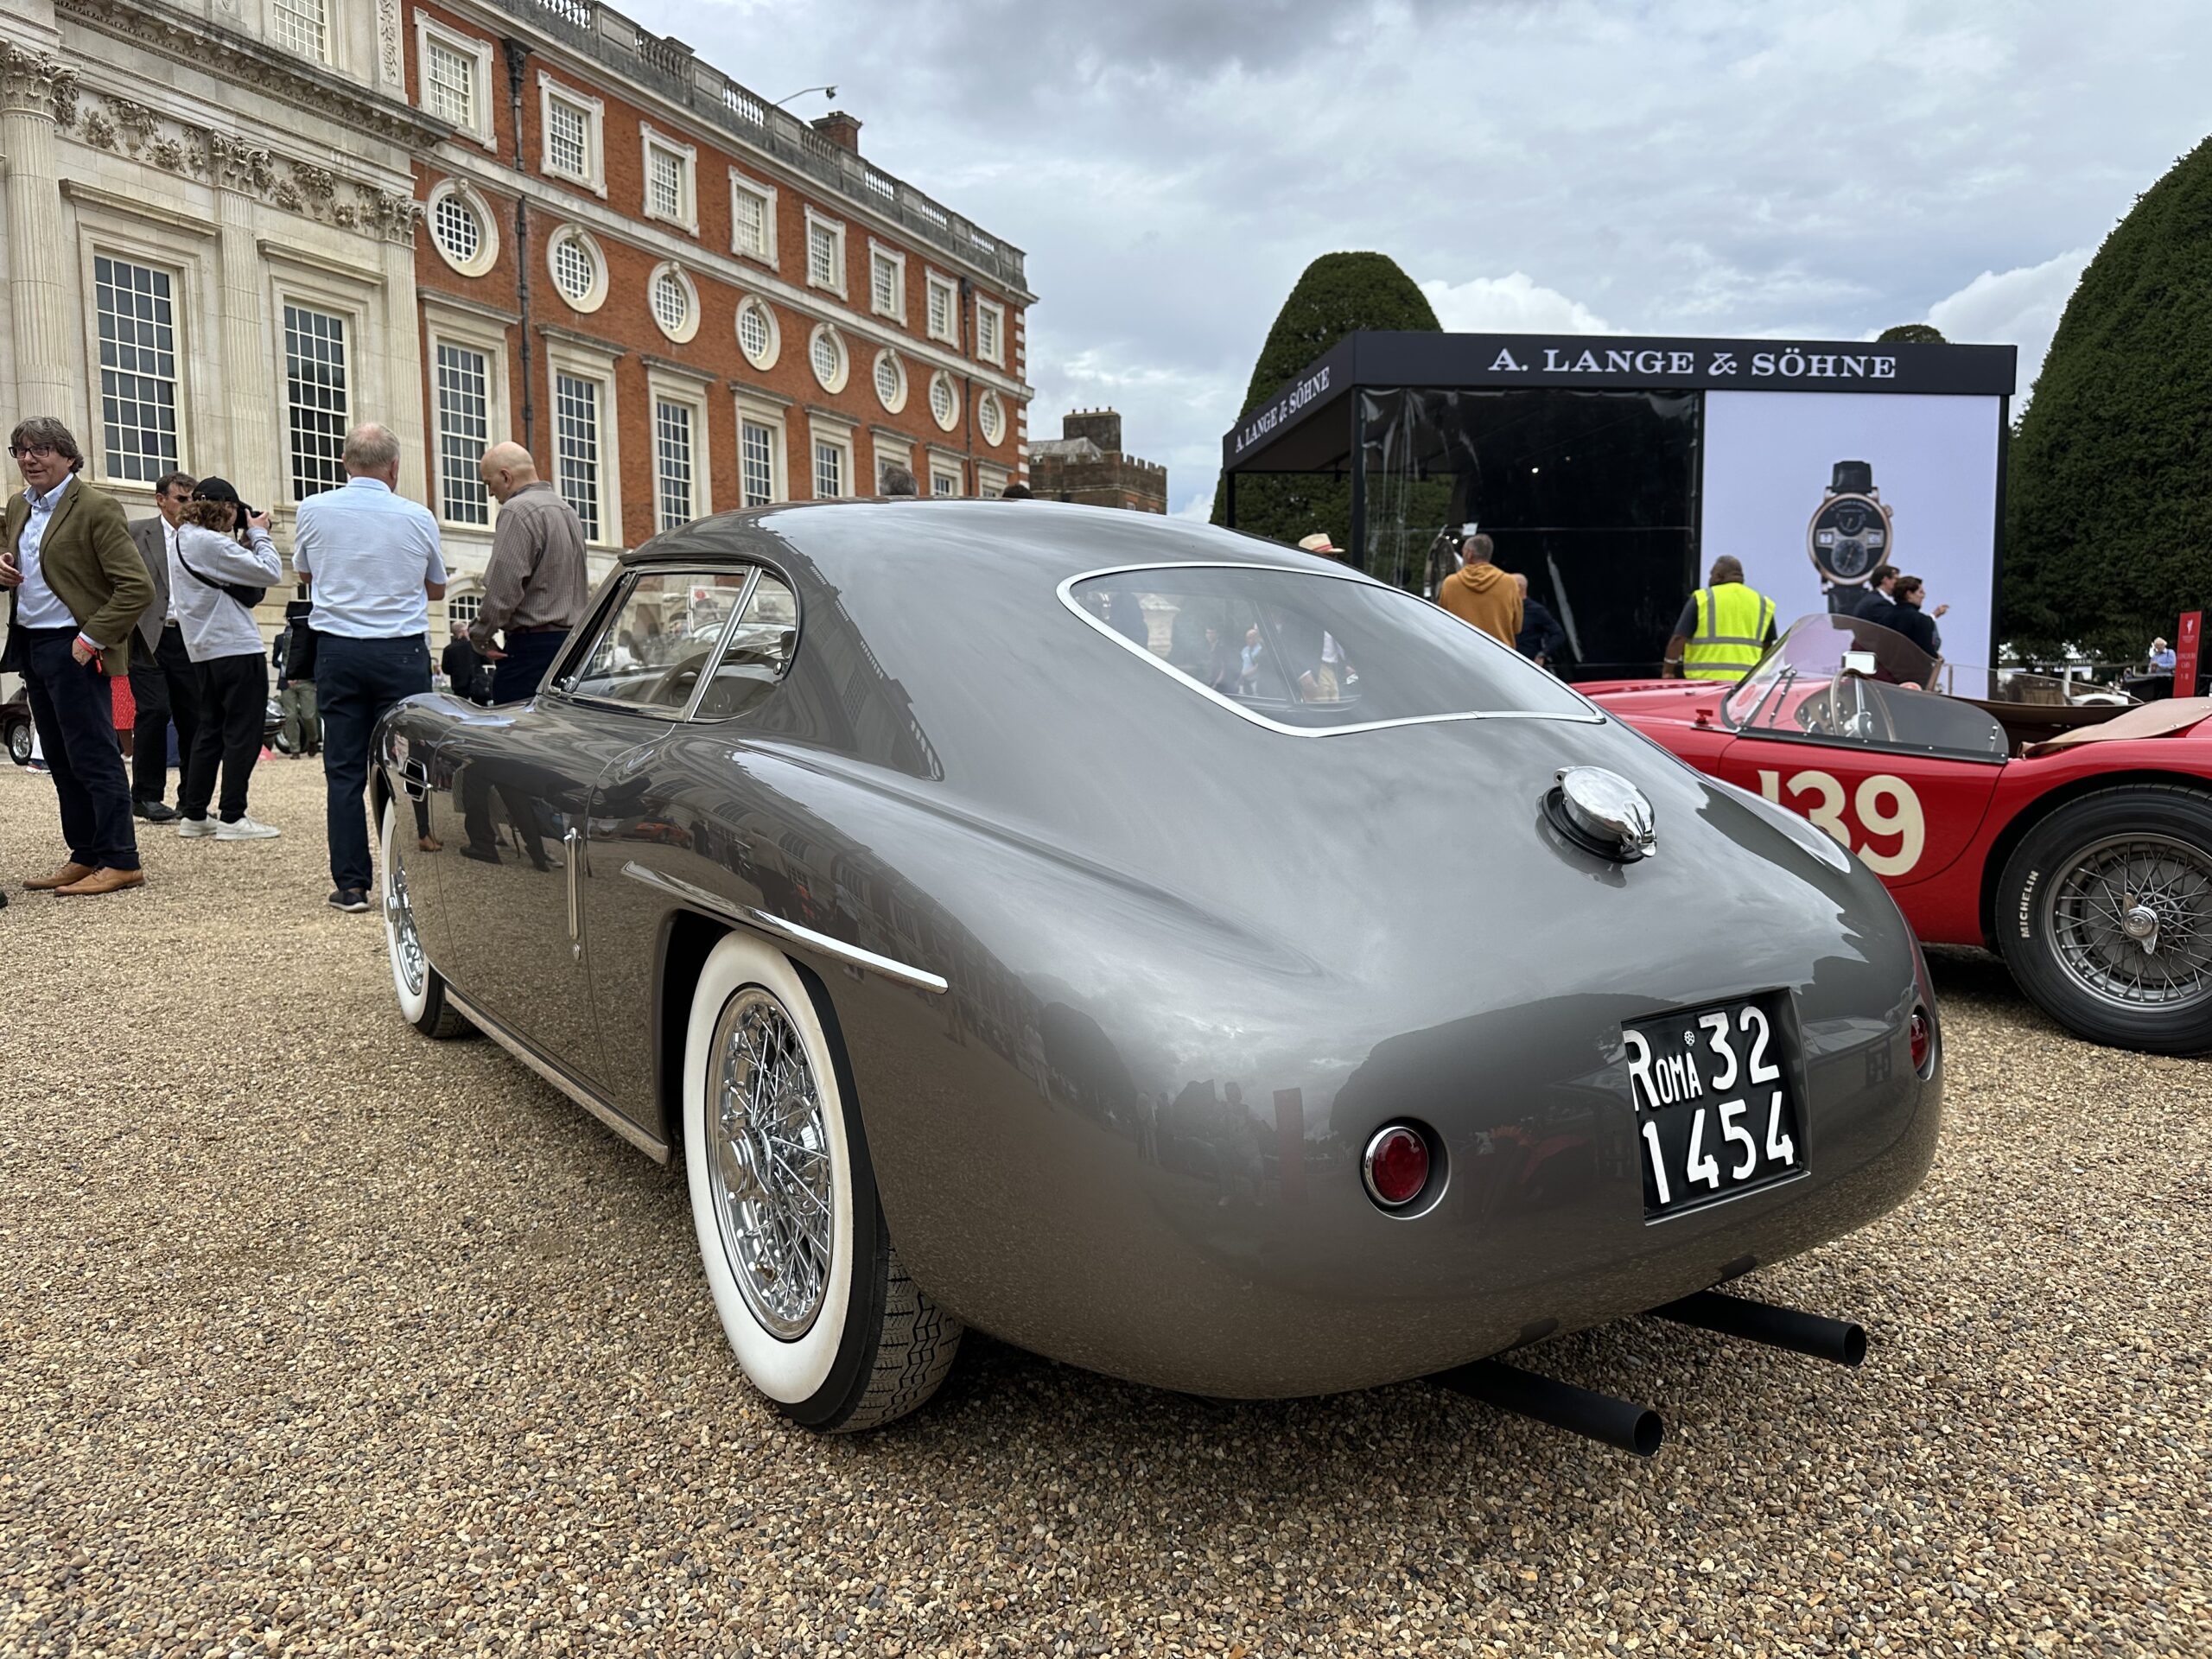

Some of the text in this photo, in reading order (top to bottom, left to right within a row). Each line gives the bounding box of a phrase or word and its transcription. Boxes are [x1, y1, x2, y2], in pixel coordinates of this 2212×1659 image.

[1487, 346, 1897, 378] A. LANGE & SÖHNE
[1244, 405, 1278, 447] LANGE
[1279, 399, 1287, 423] &
[1288, 365, 1330, 414] SÖHNE
[2018, 869, 2039, 938] MICHELIN
[1698, 1006, 1780, 1090] 32
